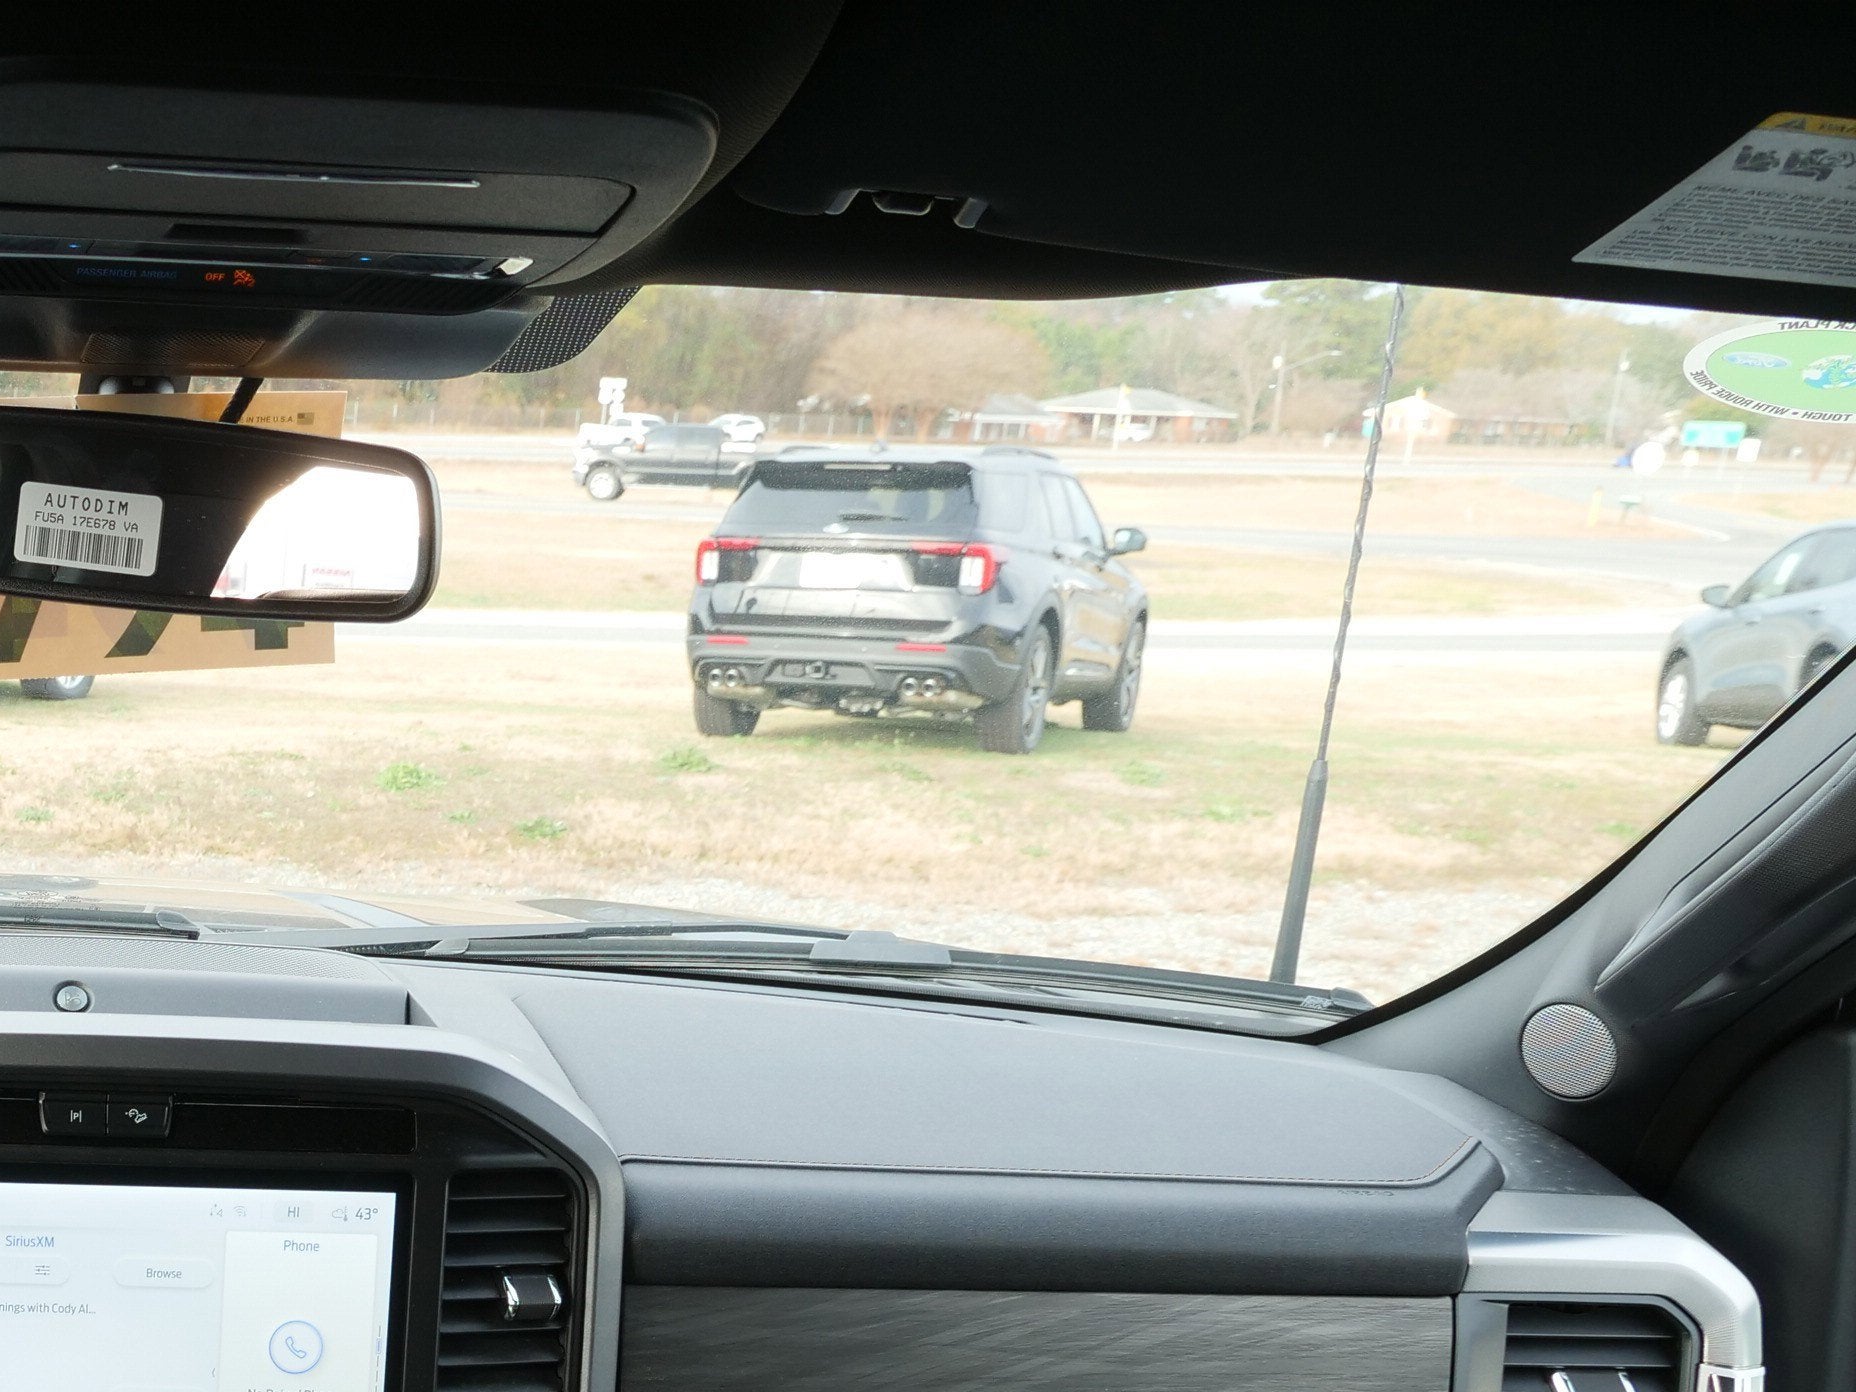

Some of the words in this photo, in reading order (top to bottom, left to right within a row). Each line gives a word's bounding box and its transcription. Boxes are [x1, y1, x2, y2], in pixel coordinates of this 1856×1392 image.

[76, 266, 136, 278] PASSENGER
[140, 269, 177, 280] AIRBAG
[205, 272, 225, 282] OFF
[44, 492, 129, 516] AUTODIM
[72, 516, 116, 531] 17E678
[123, 522, 139, 533] VA
[288, 1206, 300, 1218] HI
[6, 1236, 55, 1248] SiriusXM
[284, 1240, 320, 1252] Phone
[146, 1268, 182, 1279] Browse
[31, 1303, 50, 1313] with
[52, 1304, 76, 1315] Cody
